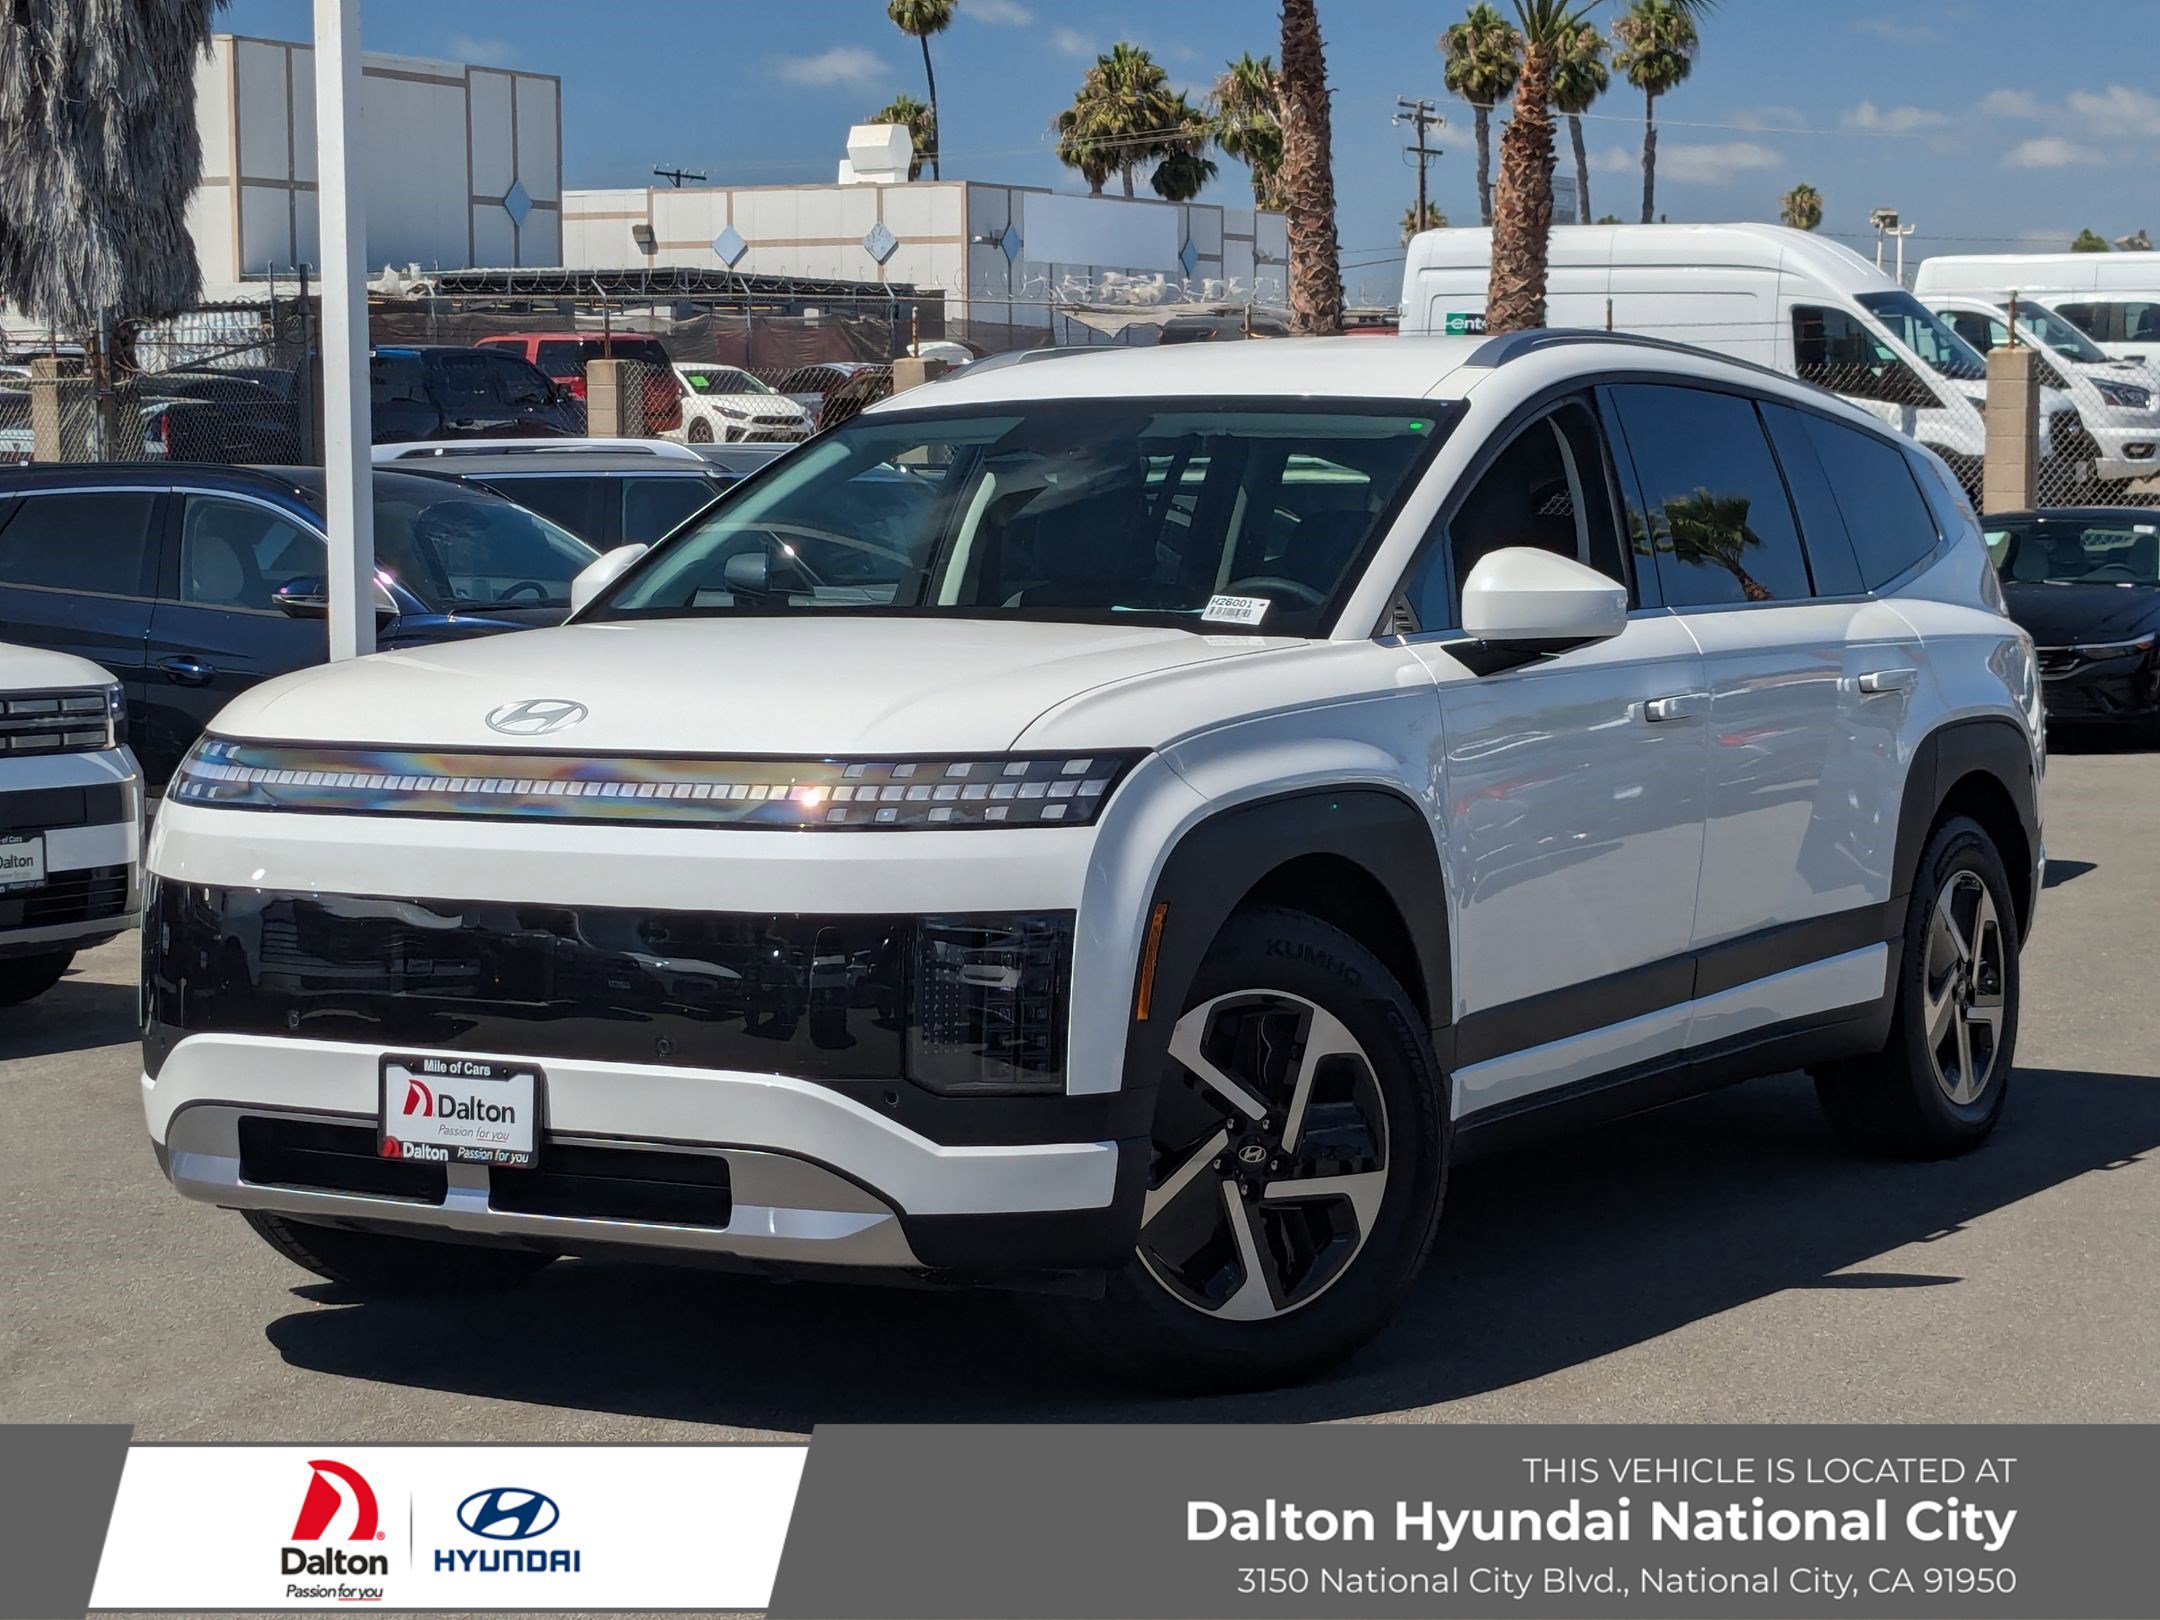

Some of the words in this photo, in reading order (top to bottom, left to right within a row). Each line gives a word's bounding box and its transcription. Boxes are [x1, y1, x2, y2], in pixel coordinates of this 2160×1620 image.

[1265, 938, 1361, 986] KUMHO
[424, 1059, 447, 1073] Mile
[449, 1061, 462, 1074] of
[464, 1062, 491, 1076] Cars
[438, 1094, 515, 1124] Dalton
[438, 1124, 473, 1137] Passion
[476, 1127, 490, 1139] for
[491, 1130, 510, 1141] you
[403, 1141, 449, 1161] Dalton
[457, 1146, 493, 1161] Passion
[494, 1149, 510, 1162] for
[510, 1151, 529, 1164] you
